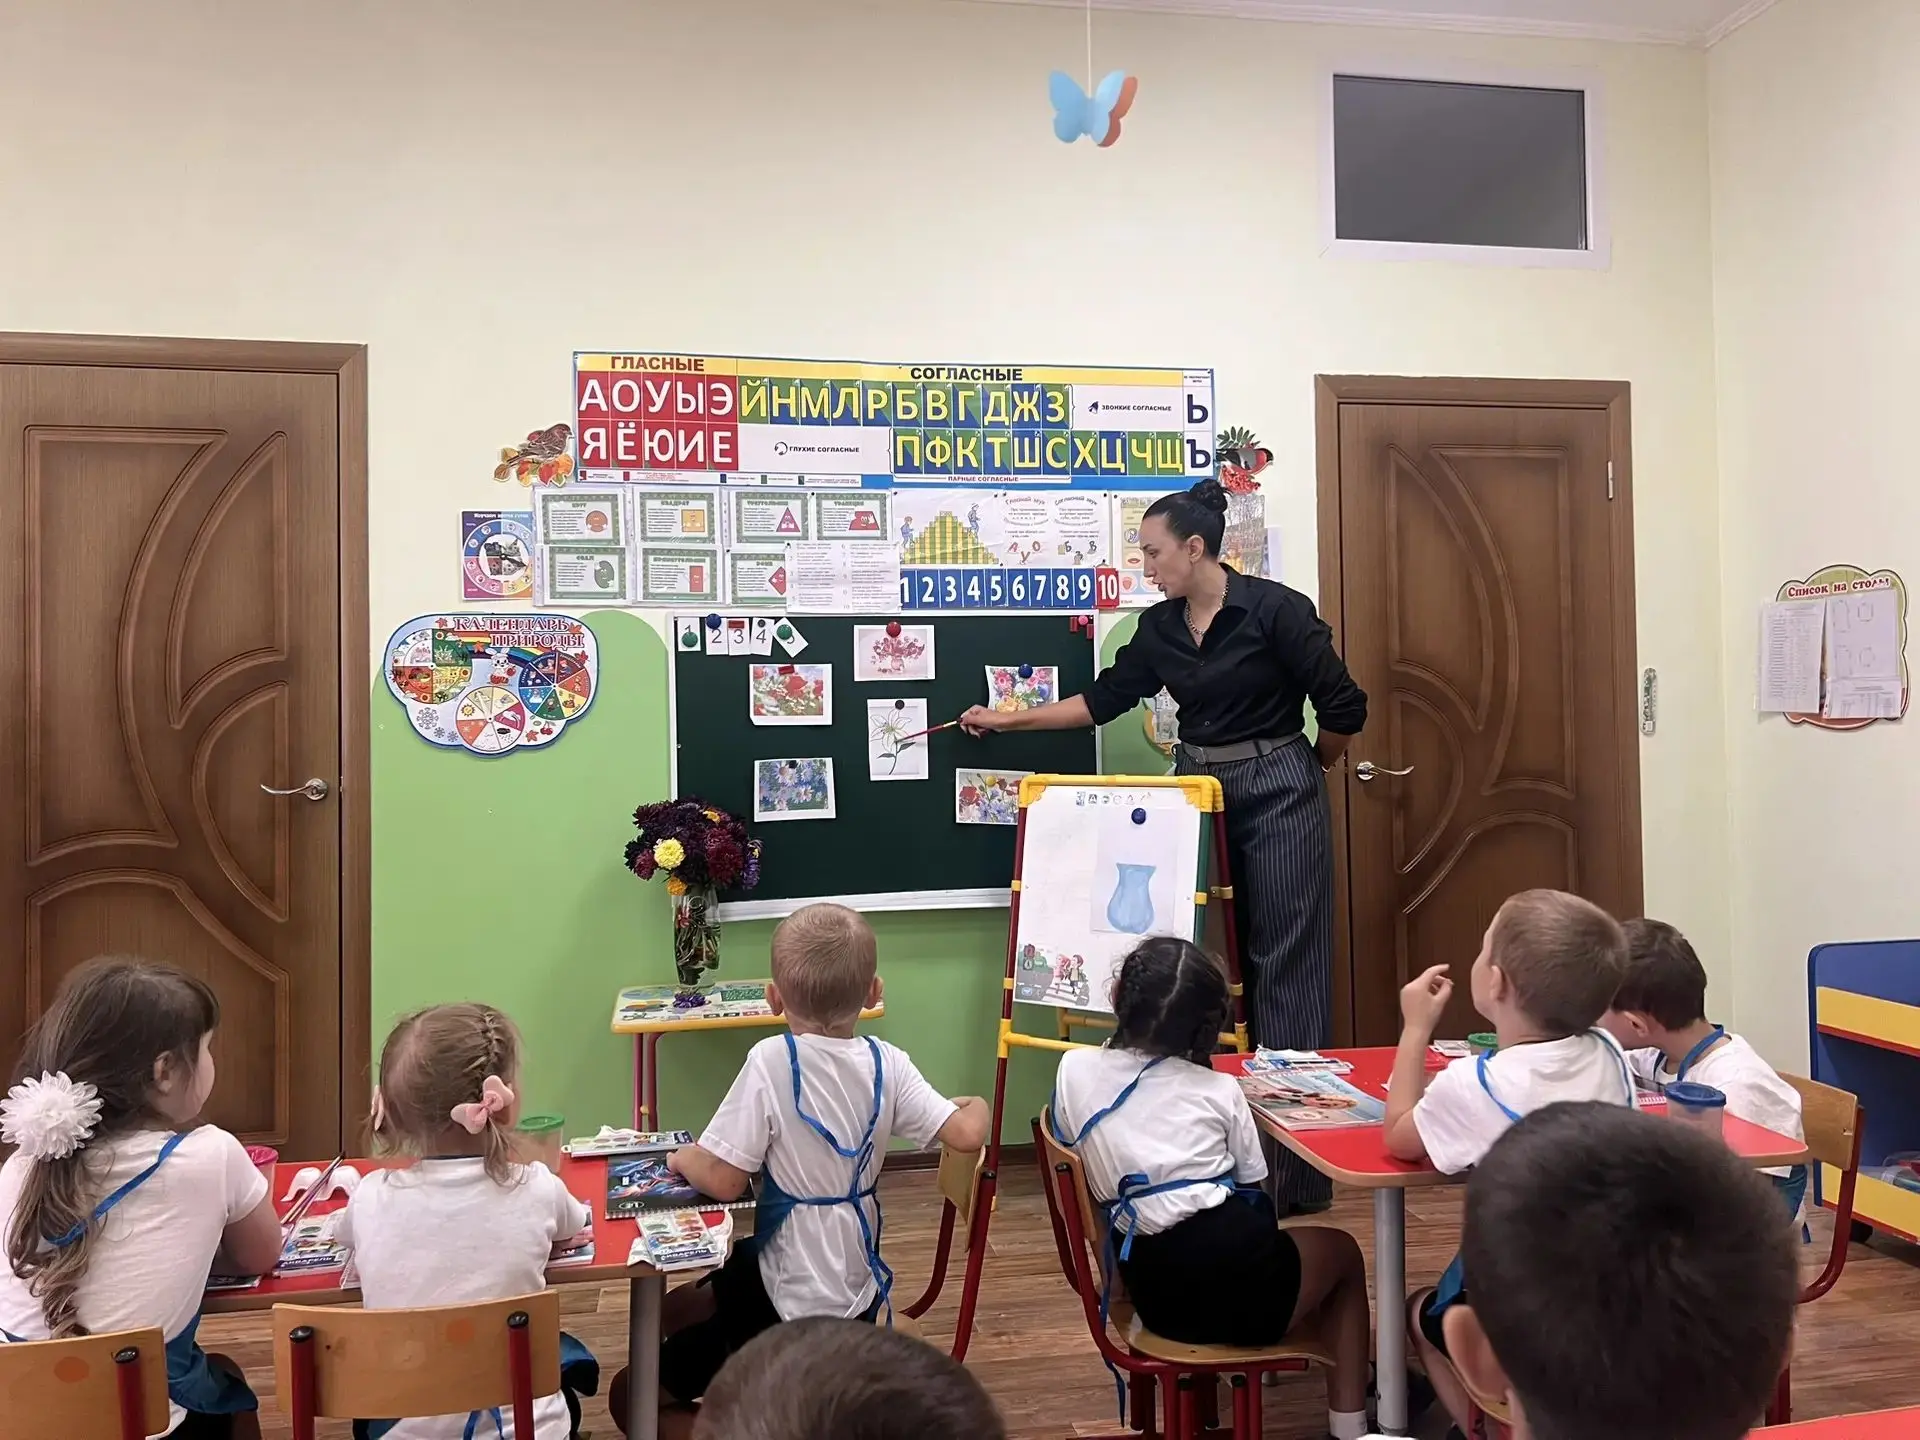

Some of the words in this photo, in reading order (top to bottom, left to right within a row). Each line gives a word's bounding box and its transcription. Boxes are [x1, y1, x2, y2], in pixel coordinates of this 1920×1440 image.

[611, 356, 704, 371] ГЛАСНЫЕ
[911, 368, 1022, 381] СОГЛАСНЫЕ
[1187, 394, 1208, 424] Ь
[1186, 440, 1210, 468] Ъ
[922, 576, 934, 602] 2
[945, 576, 957, 601] 3
[967, 576, 980, 601] 4
[991, 575, 1002, 601] 5
[1012, 575, 1025, 601] 6
[1034, 575, 1047, 600] 7
[1056, 575, 1069, 600] 8
[1078, 574, 1091, 600] 9
[1099, 574, 1118, 600] 10
[1788, 586, 1828, 597] Список
[1834, 583, 1847, 591] на
[454, 617, 569, 632] КАЛЕНДАРЬ
[490, 631, 584, 650] ПРИРОДЫ
[712, 628, 722, 644] 2
[734, 629, 744, 643] 3
[756, 629, 766, 643] 4
